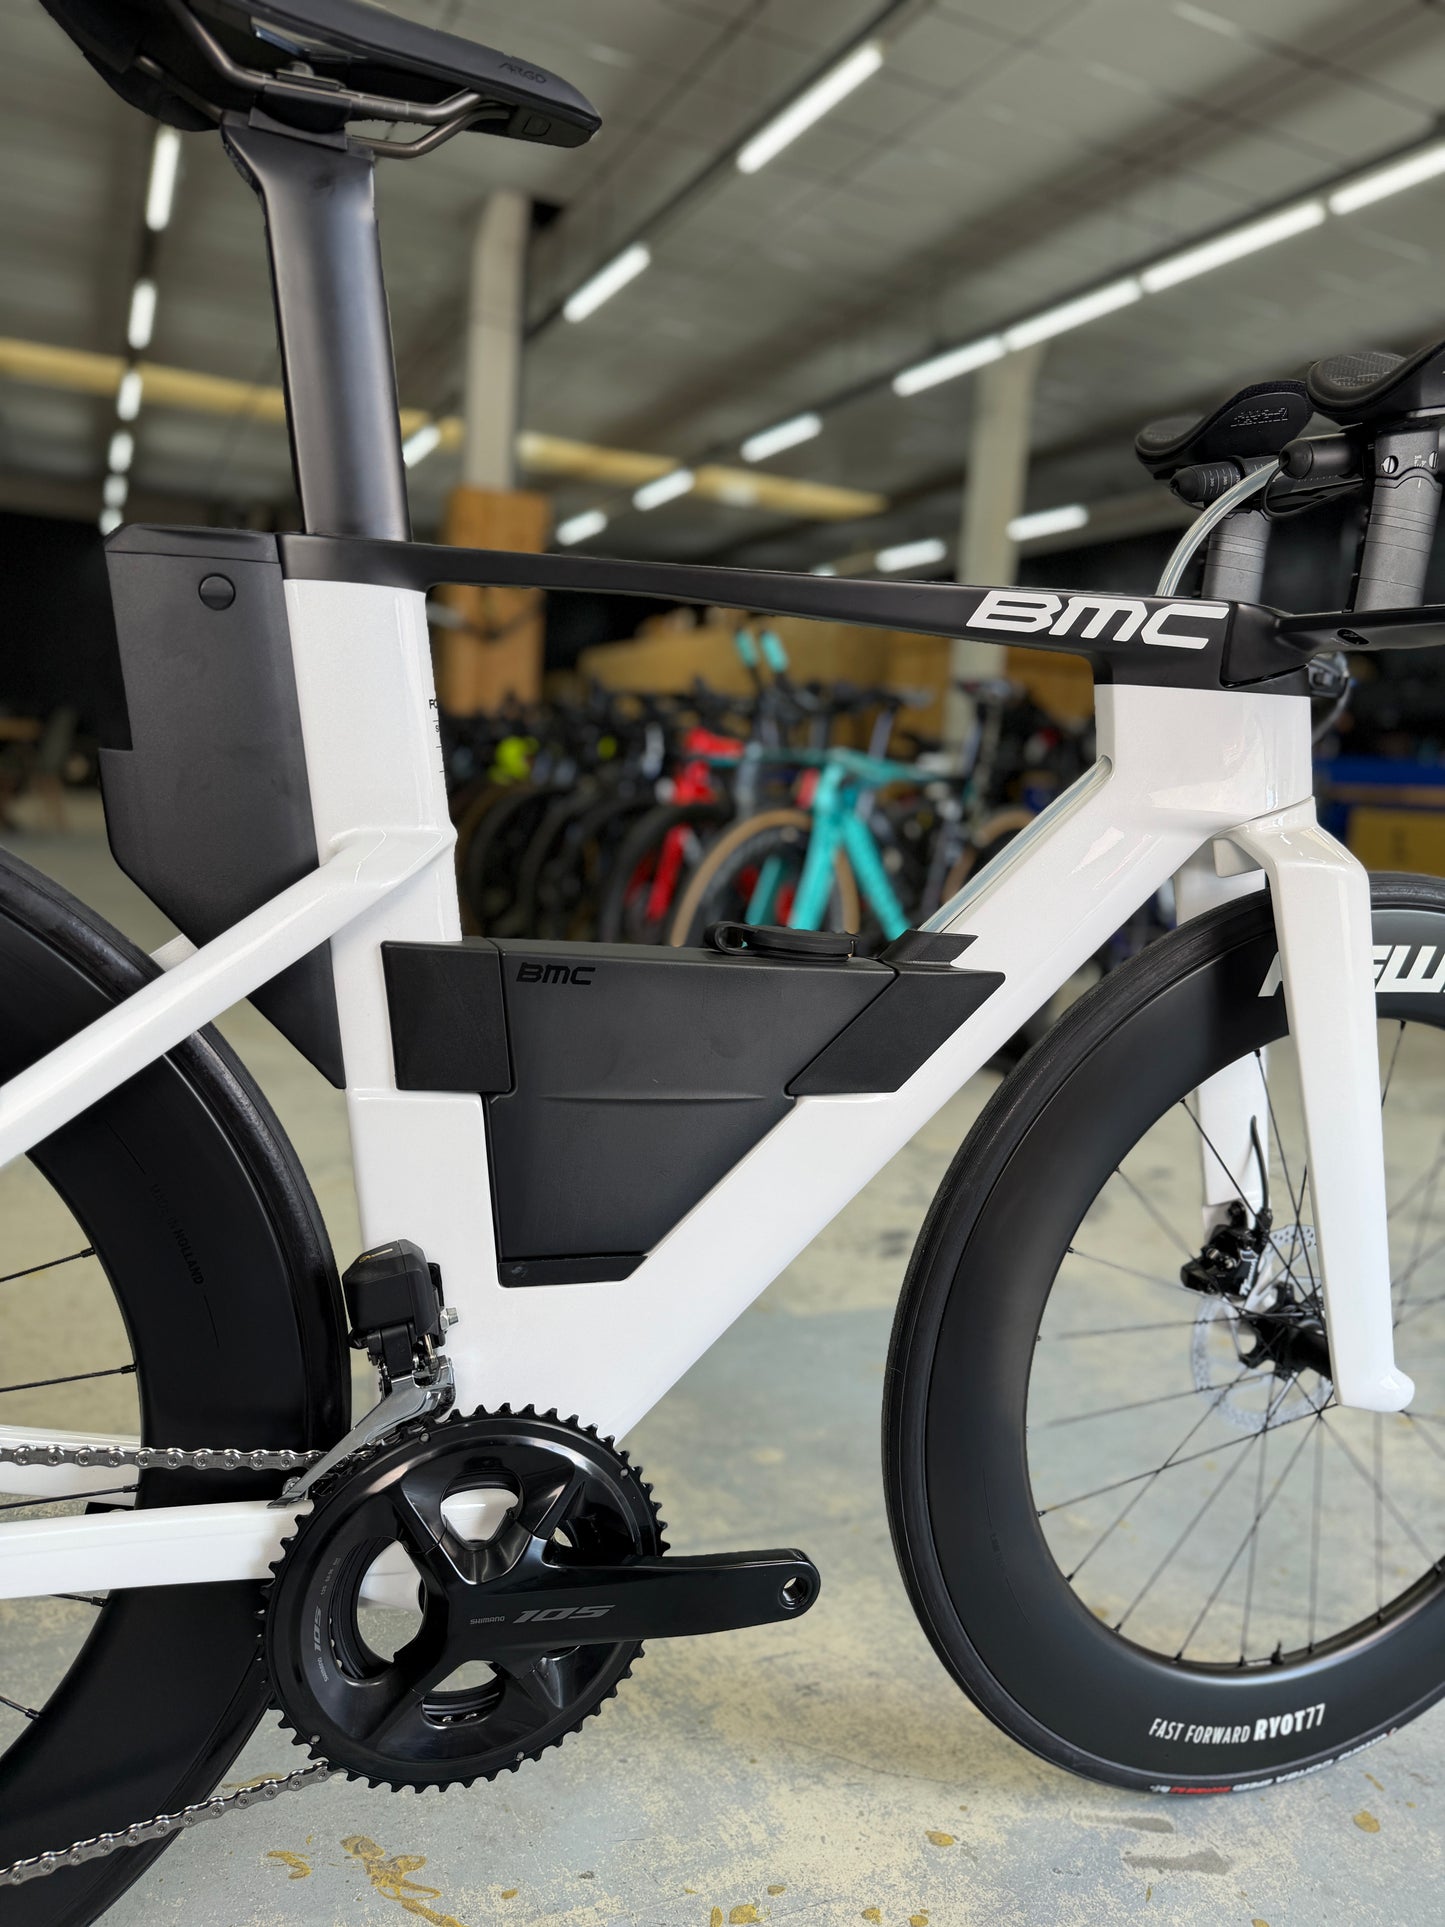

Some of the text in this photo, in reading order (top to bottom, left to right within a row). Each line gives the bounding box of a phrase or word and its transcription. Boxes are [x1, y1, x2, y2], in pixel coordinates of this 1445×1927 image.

[499, 62, 546, 84] ARGO
[966, 590, 1229, 650] BMC
[516, 962, 596, 985] BMC
[173, 1228, 205, 1285] HOLLAND
[470, 1604, 616, 1625] SHIMANO 105
[1148, 1703, 1326, 1744] FAST FORWARD RYOT77
